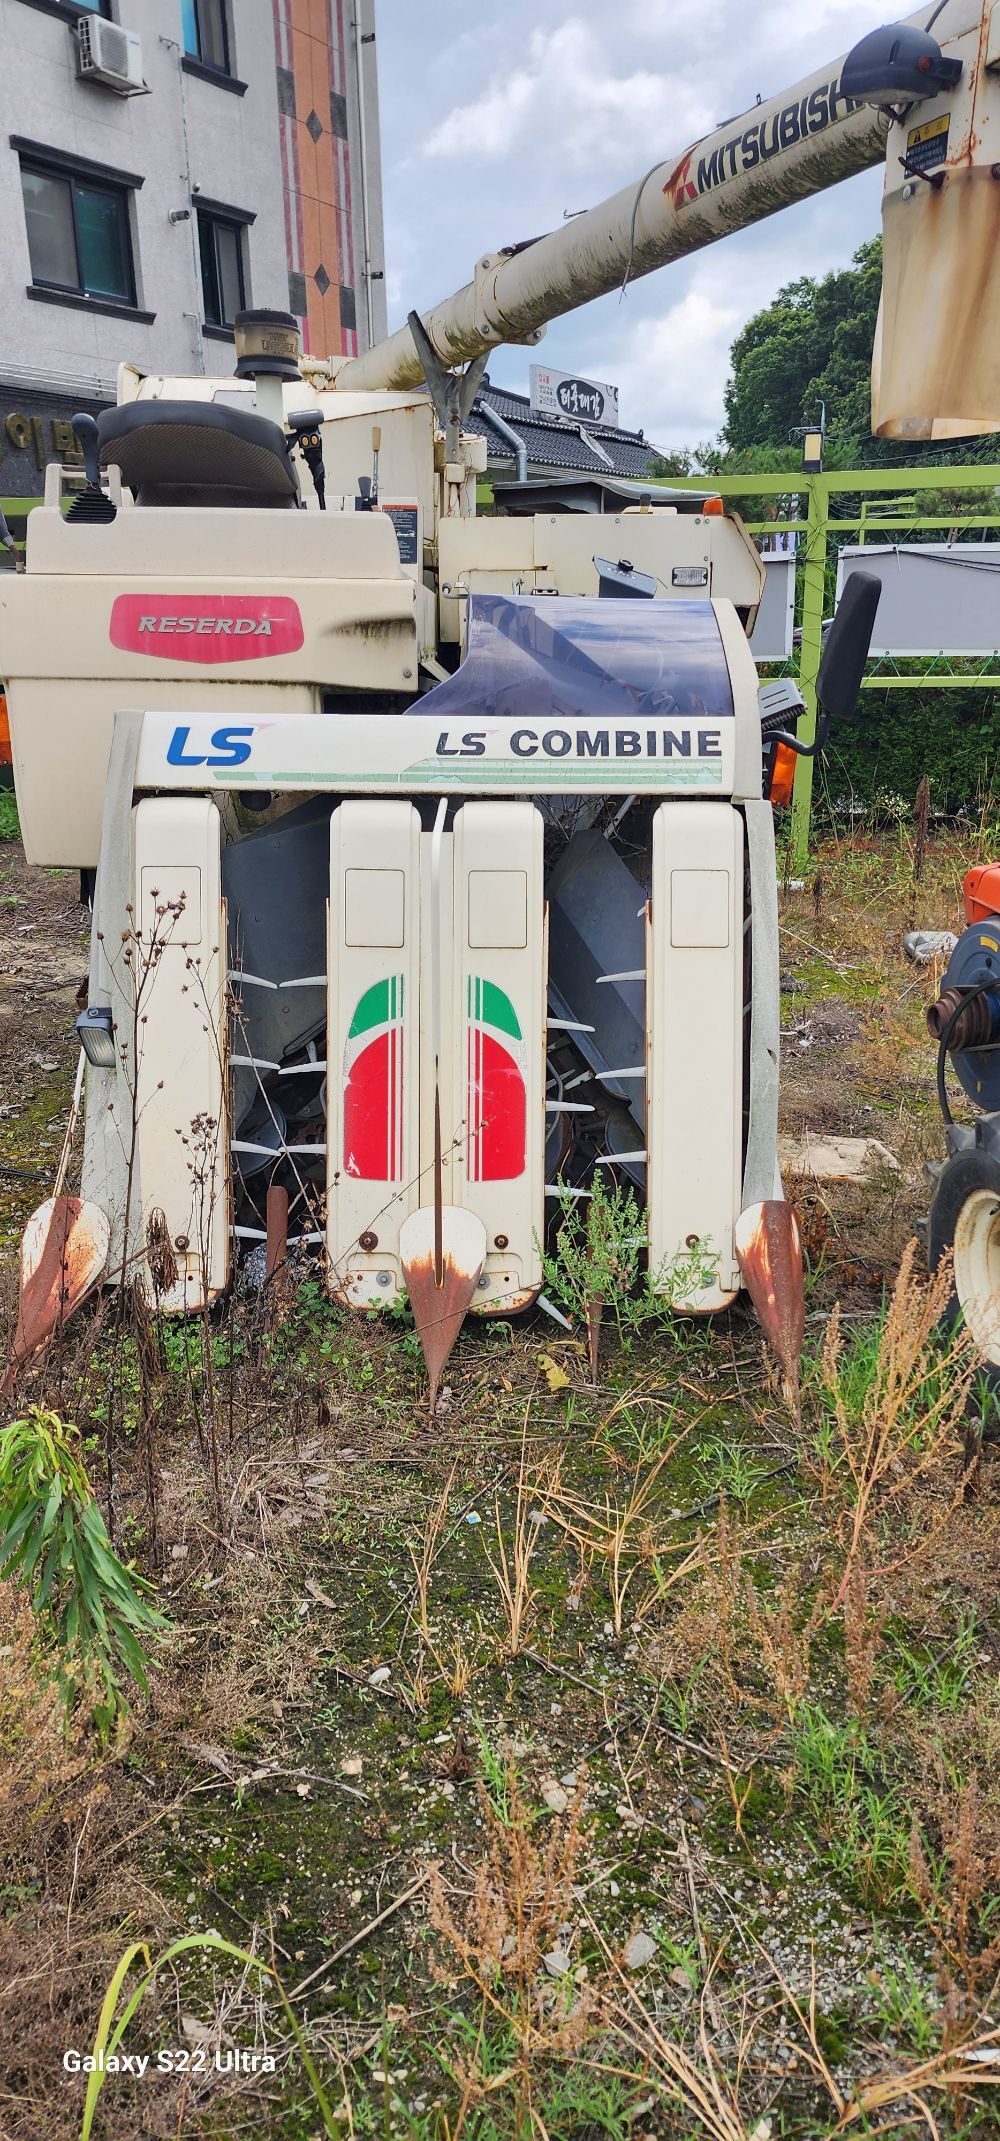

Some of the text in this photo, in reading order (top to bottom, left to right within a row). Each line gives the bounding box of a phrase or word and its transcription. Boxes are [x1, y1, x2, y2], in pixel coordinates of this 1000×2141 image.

[698, 78, 865, 194] MITSUBISH
[138, 616, 272, 635] RESERDA
[167, 727, 254, 766] LS
[435, 729, 722, 757] LS COMBINE
